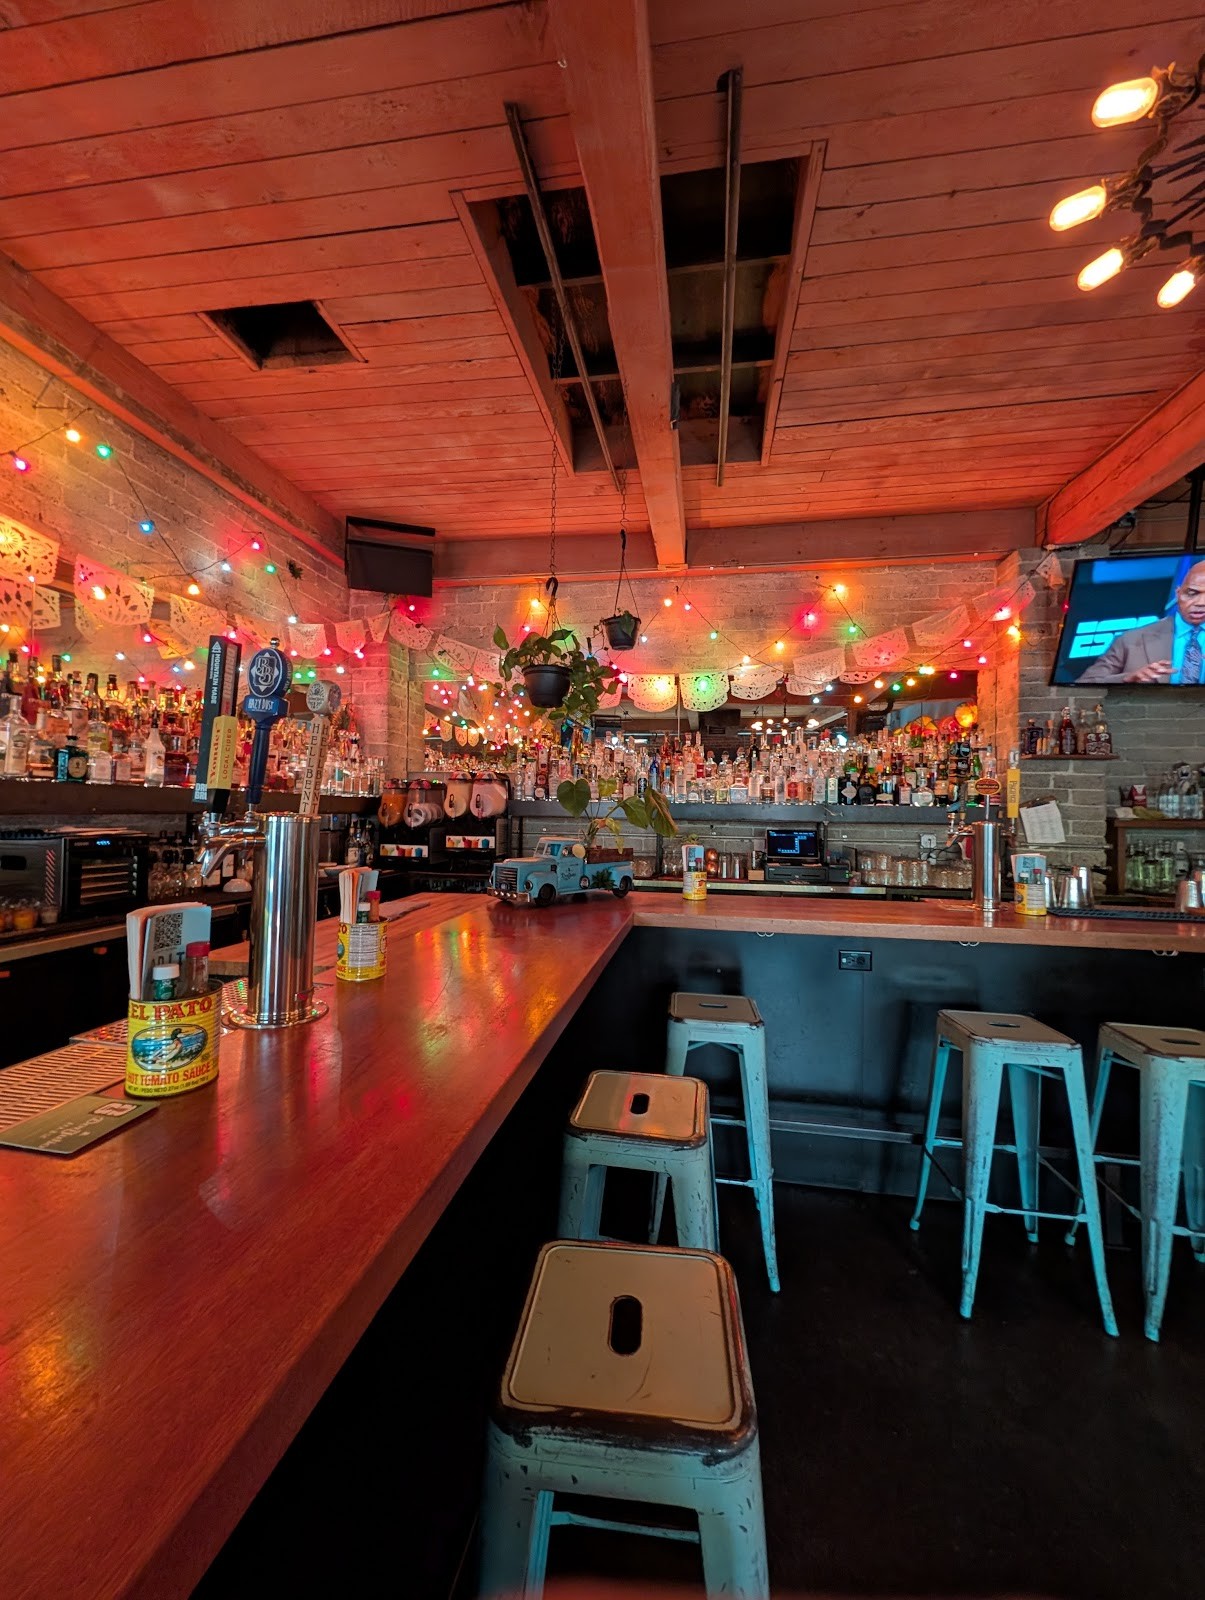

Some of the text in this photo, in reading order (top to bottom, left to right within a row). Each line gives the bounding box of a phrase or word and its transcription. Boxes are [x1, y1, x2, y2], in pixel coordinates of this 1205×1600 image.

[212, 653, 221, 687] MOUNTAIN
[210, 686, 219, 705] MADE
[222, 728, 233, 780] LOCAL CIDER
[301, 722, 321, 813] HELLBENT
[311, 724, 330, 814] HELLBENT
[130, 996, 213, 1021] EL PATO
[140, 1071, 180, 1087] TOMATO
[182, 1061, 211, 1081] SAUCE
